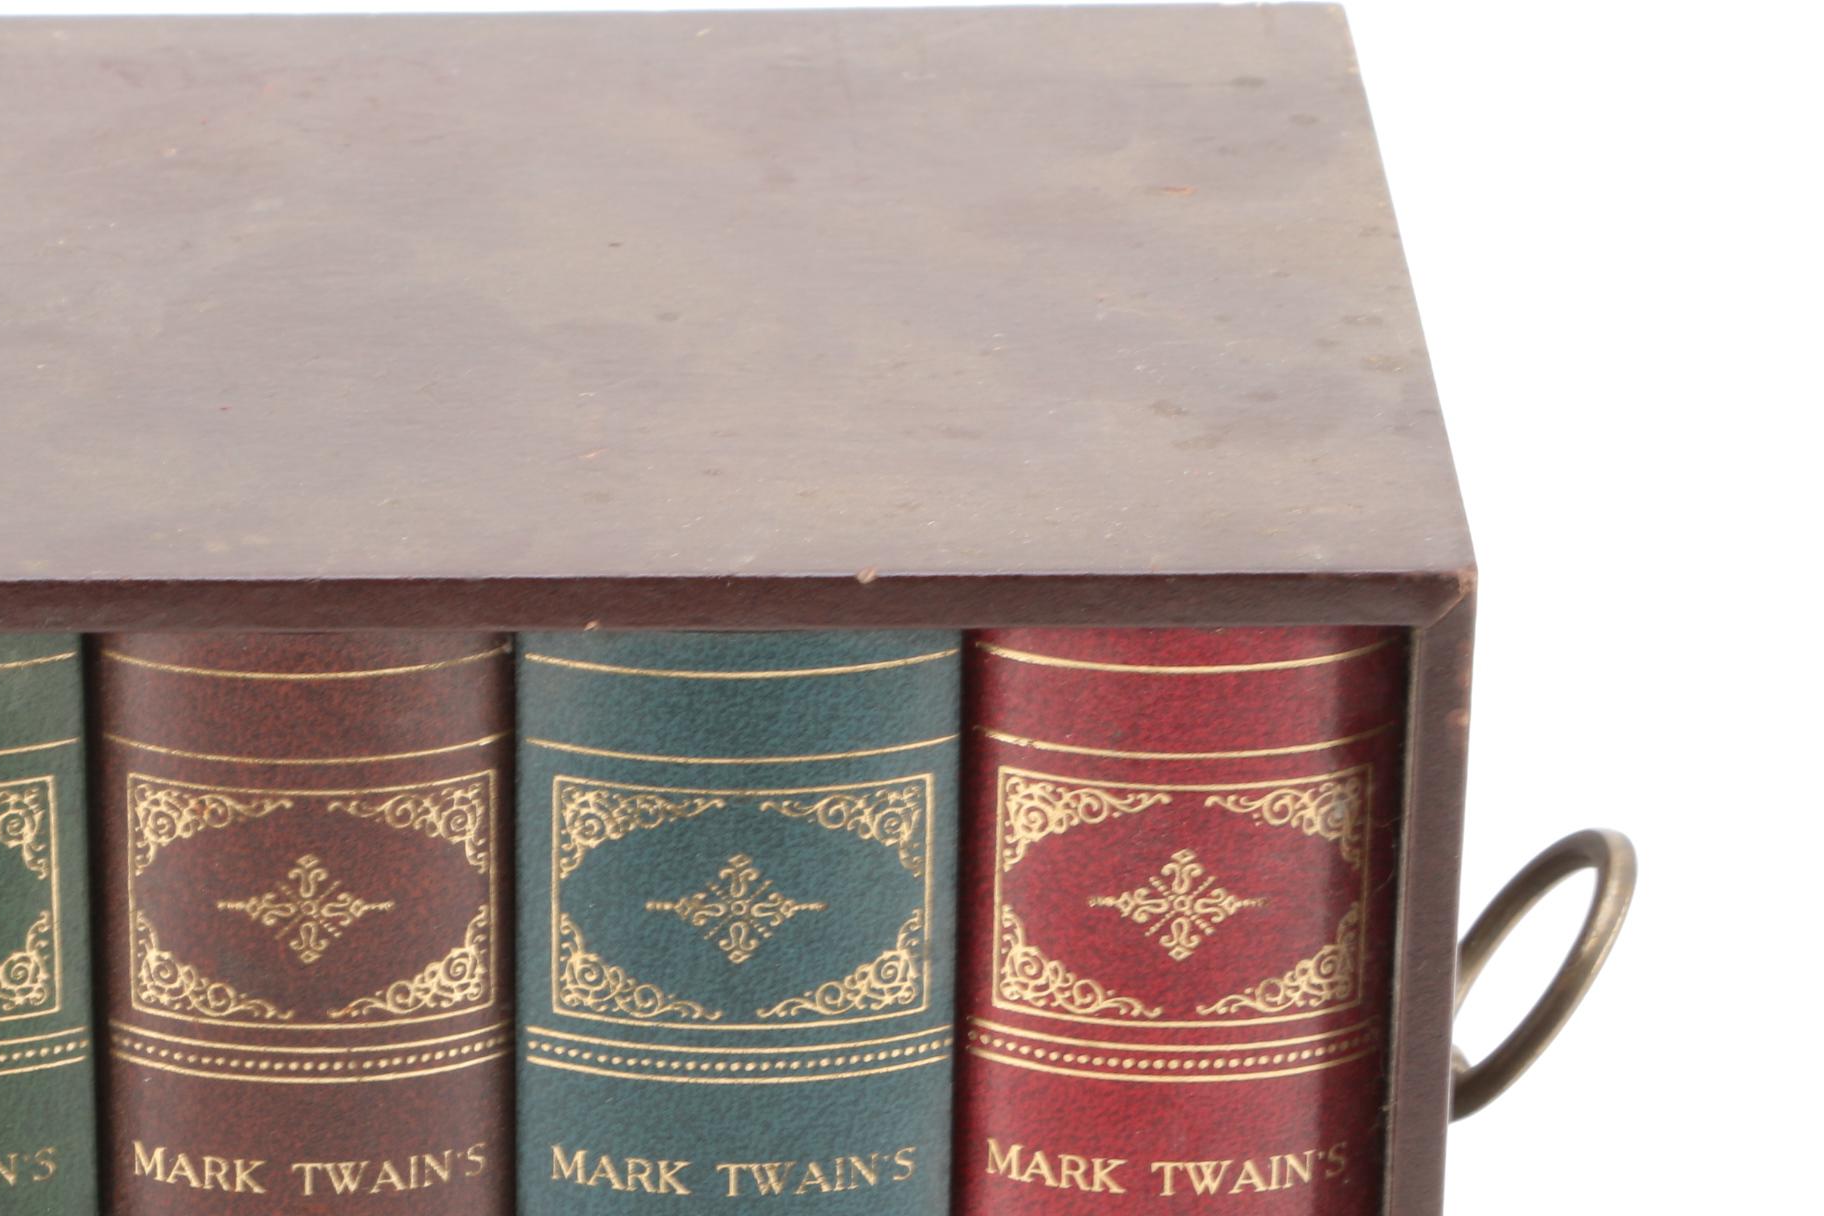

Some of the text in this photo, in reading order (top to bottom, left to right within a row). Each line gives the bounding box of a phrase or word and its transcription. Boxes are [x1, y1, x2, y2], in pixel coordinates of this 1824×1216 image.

[132, 1141, 487, 1196] MARK TWAIN'S
[550, 1144, 918, 1198] MARK TWAIN'S
[985, 1137, 1347, 1196] MARK TWAIN'S
